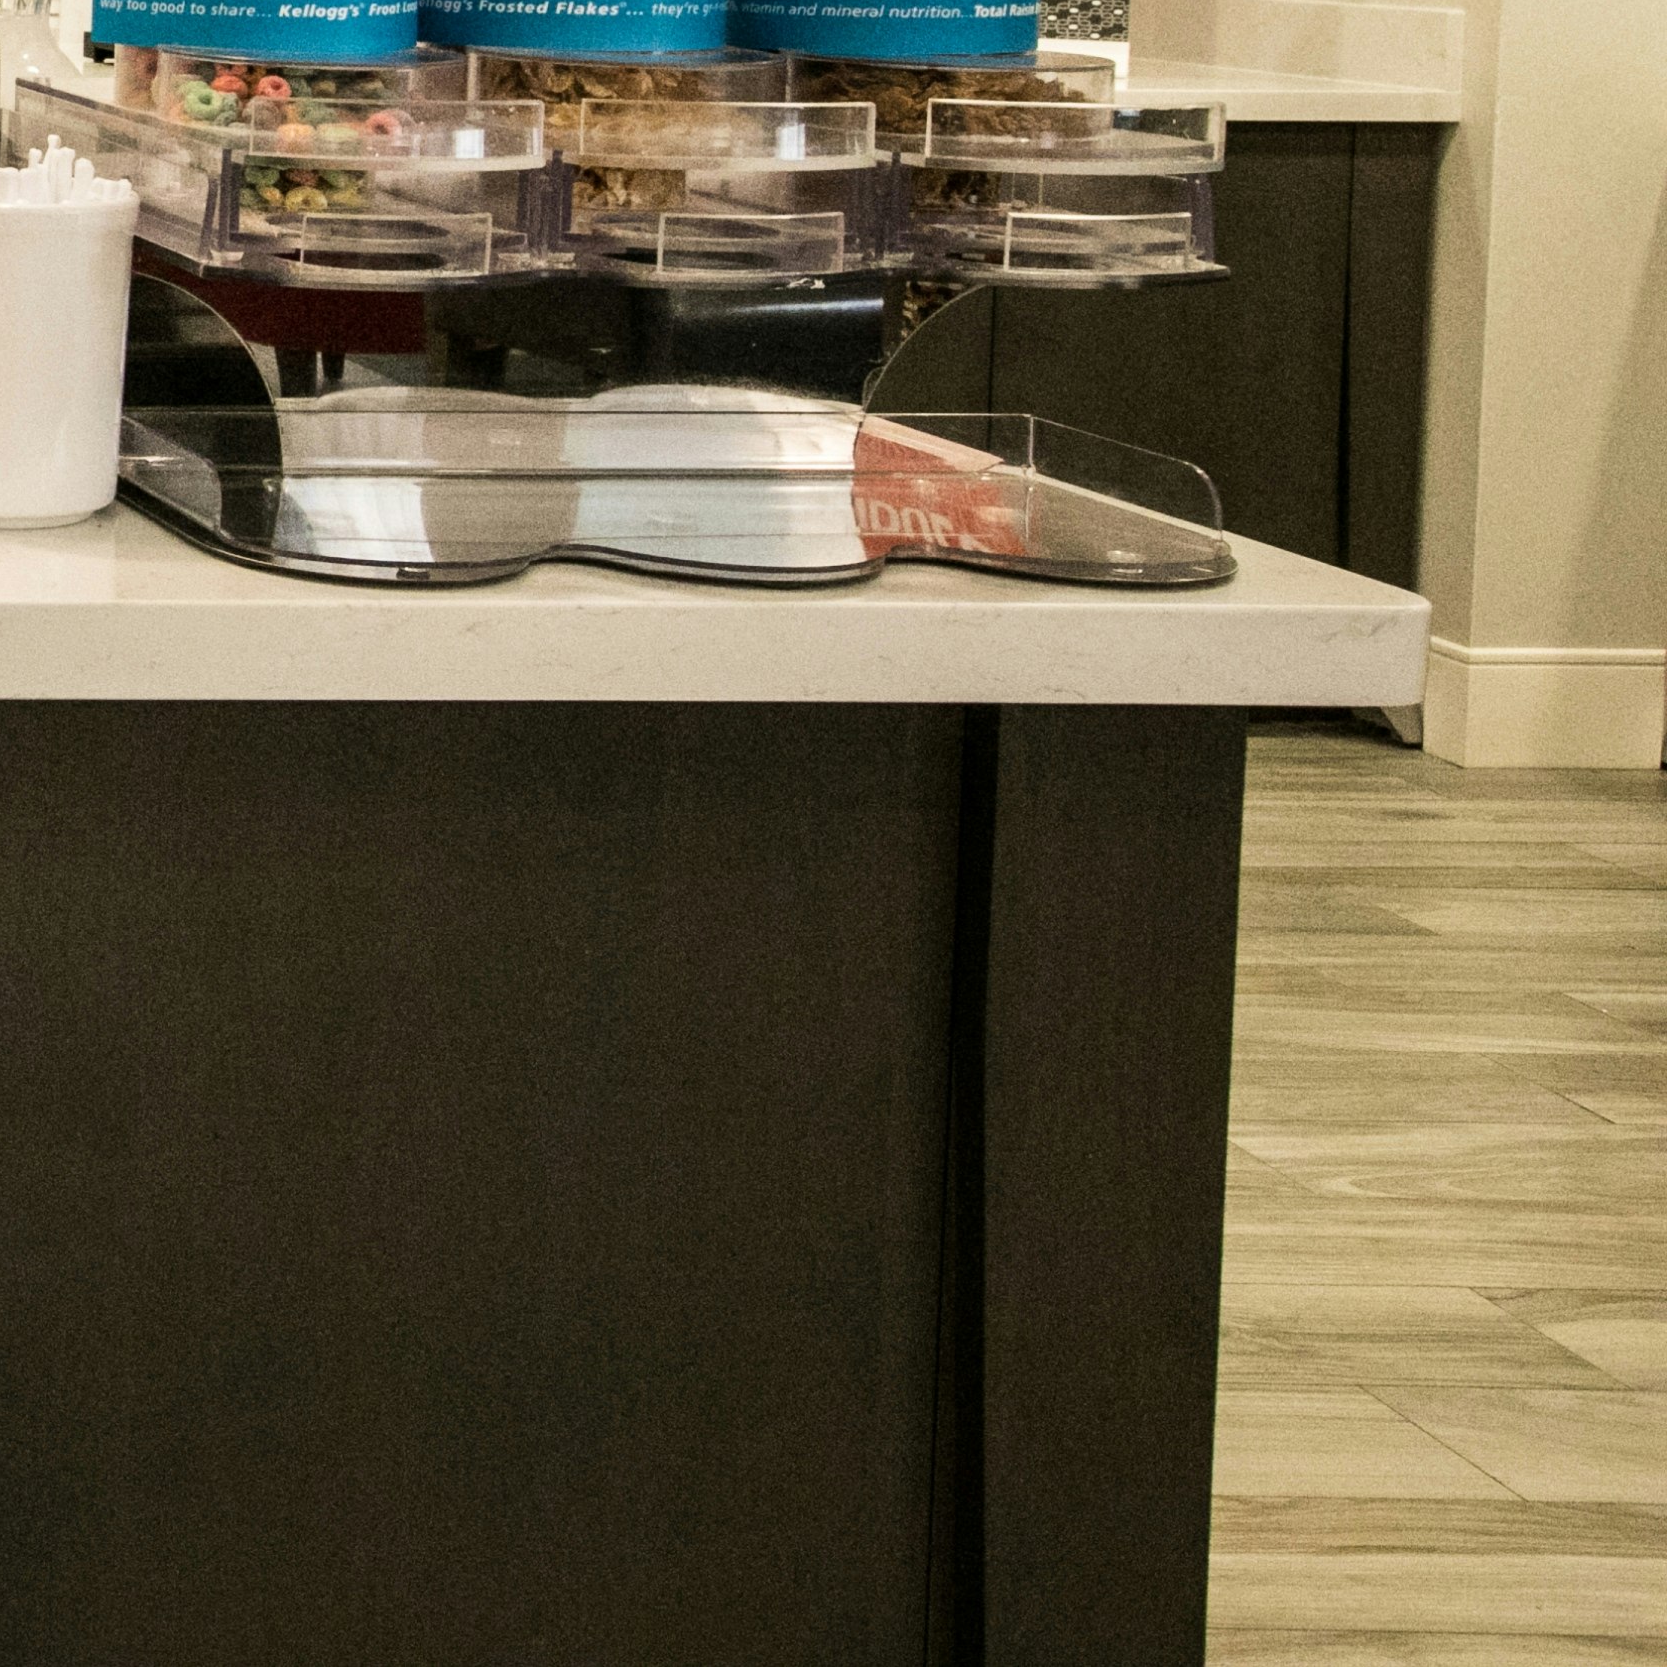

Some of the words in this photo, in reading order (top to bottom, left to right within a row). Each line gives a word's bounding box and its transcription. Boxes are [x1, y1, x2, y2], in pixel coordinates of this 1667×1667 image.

[151, 0, 185, 16] good
[190, 2, 206, 15] to
[478, 0, 549, 15] Frosted
[651, 2, 700, 18] they're
[788, 3, 817, 16] and
[821, 4, 885, 18] mineral
[974, 3, 1007, 18] Total
